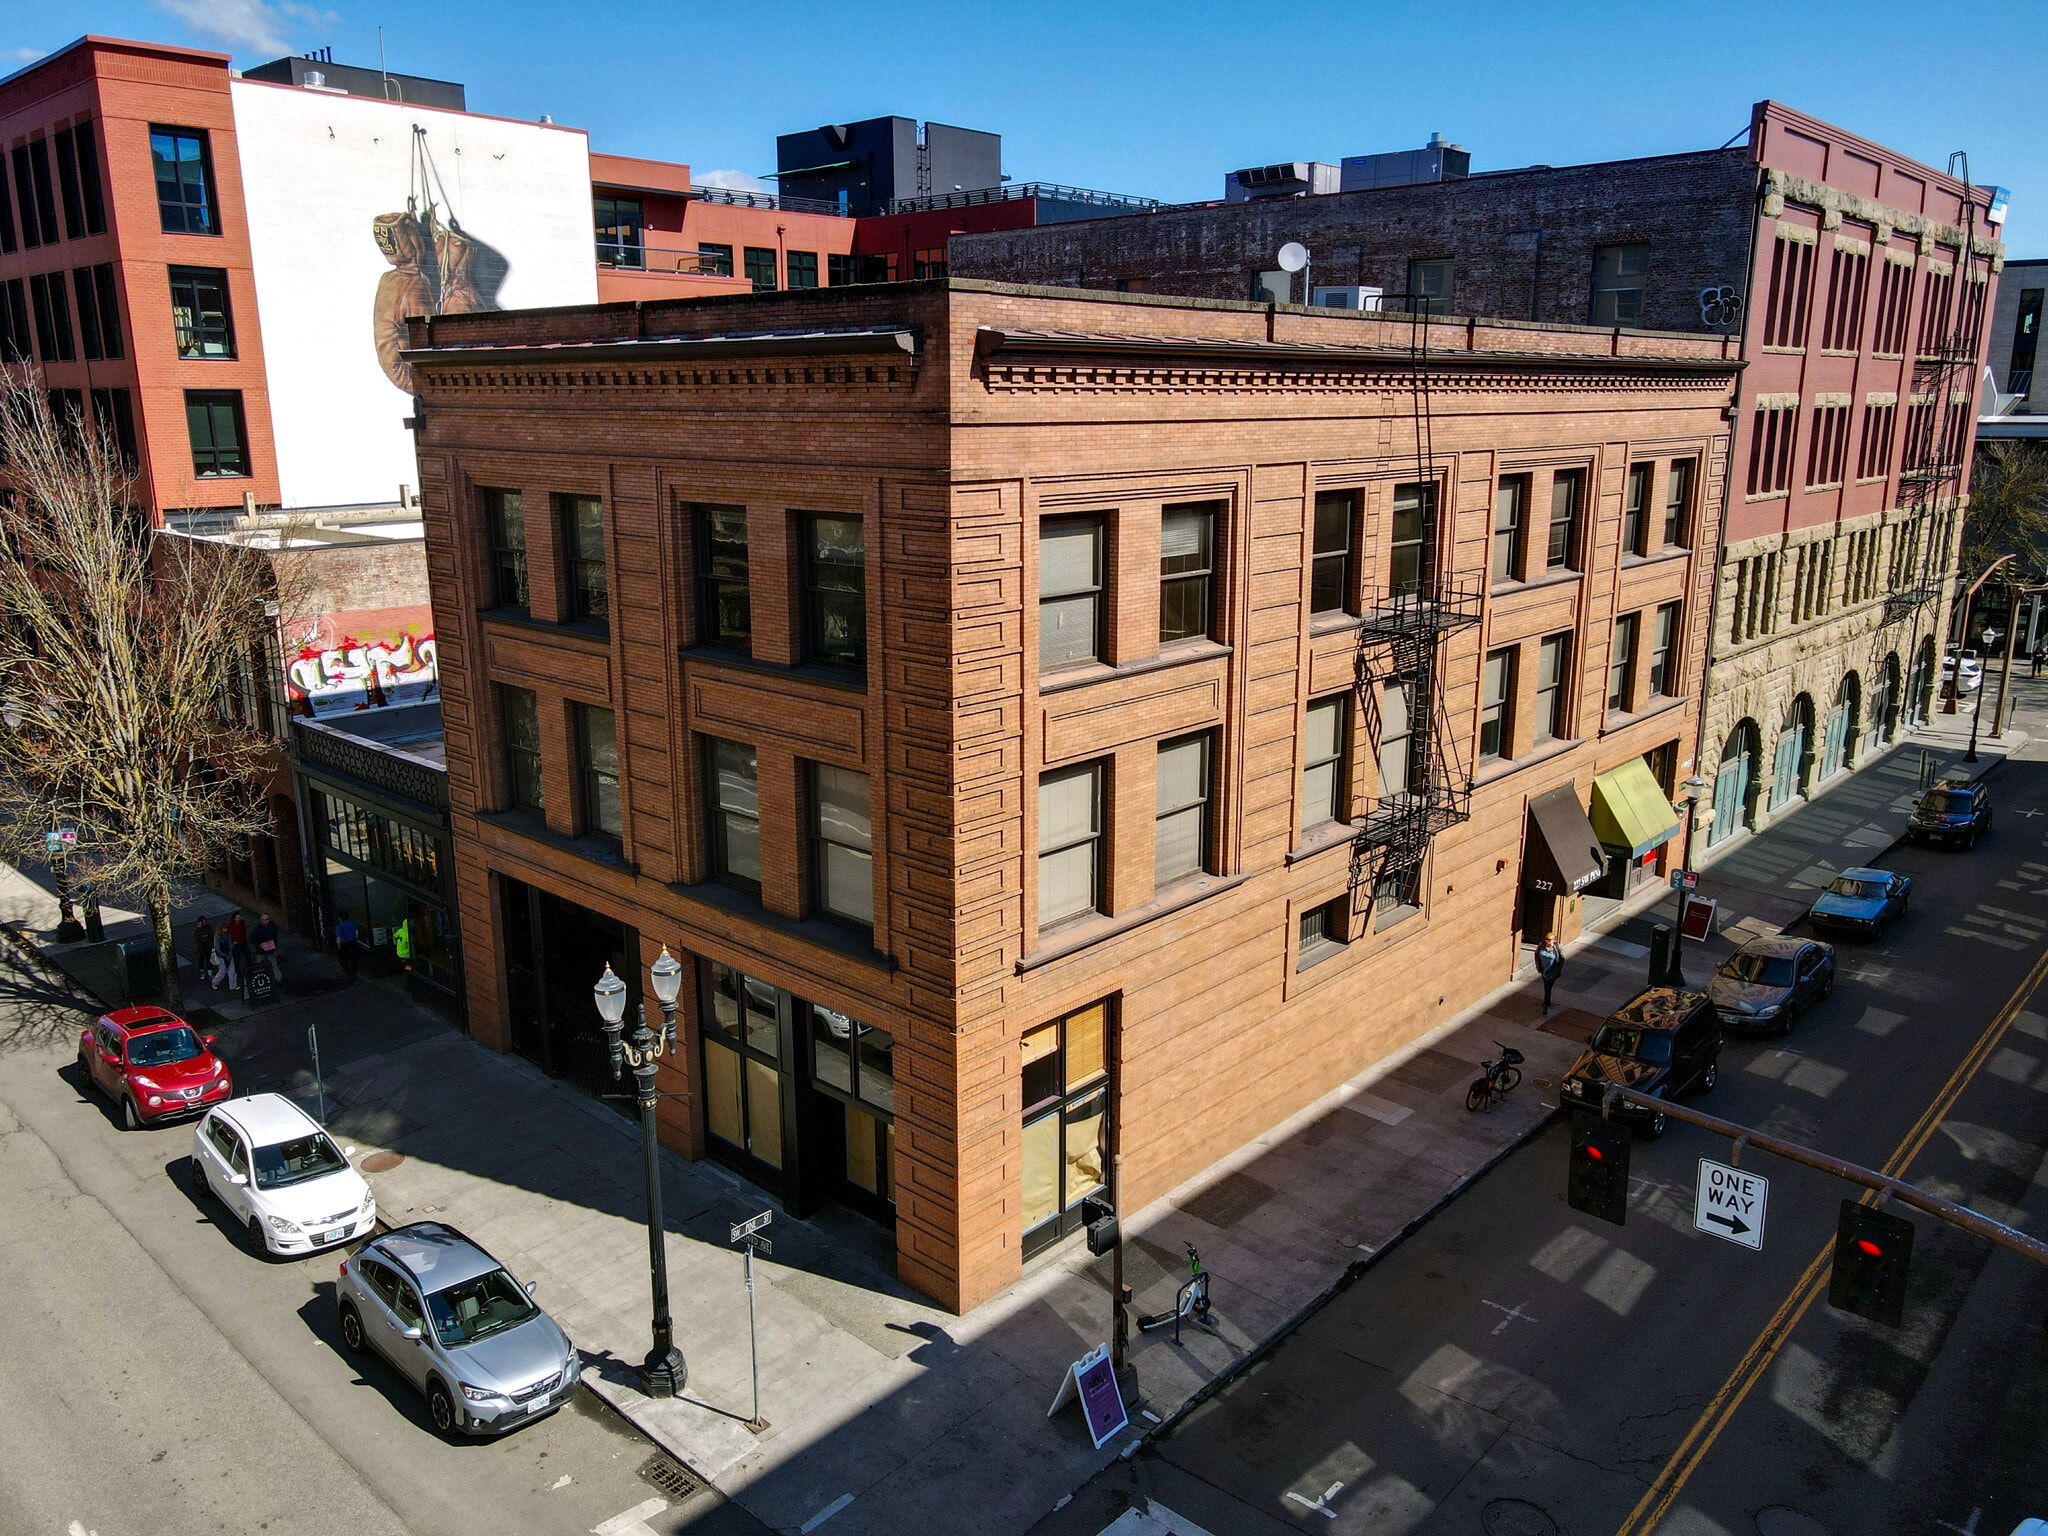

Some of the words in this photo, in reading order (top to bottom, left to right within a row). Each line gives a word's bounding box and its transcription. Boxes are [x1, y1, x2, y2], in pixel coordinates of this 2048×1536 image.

[1535, 880, 1553, 891] 227
[1711, 1169, 1755, 1197] ONE
[1708, 1187, 1755, 1215] WAY
[732, 1228, 741, 1240] SW
[763, 1213, 770, 1224] ST
